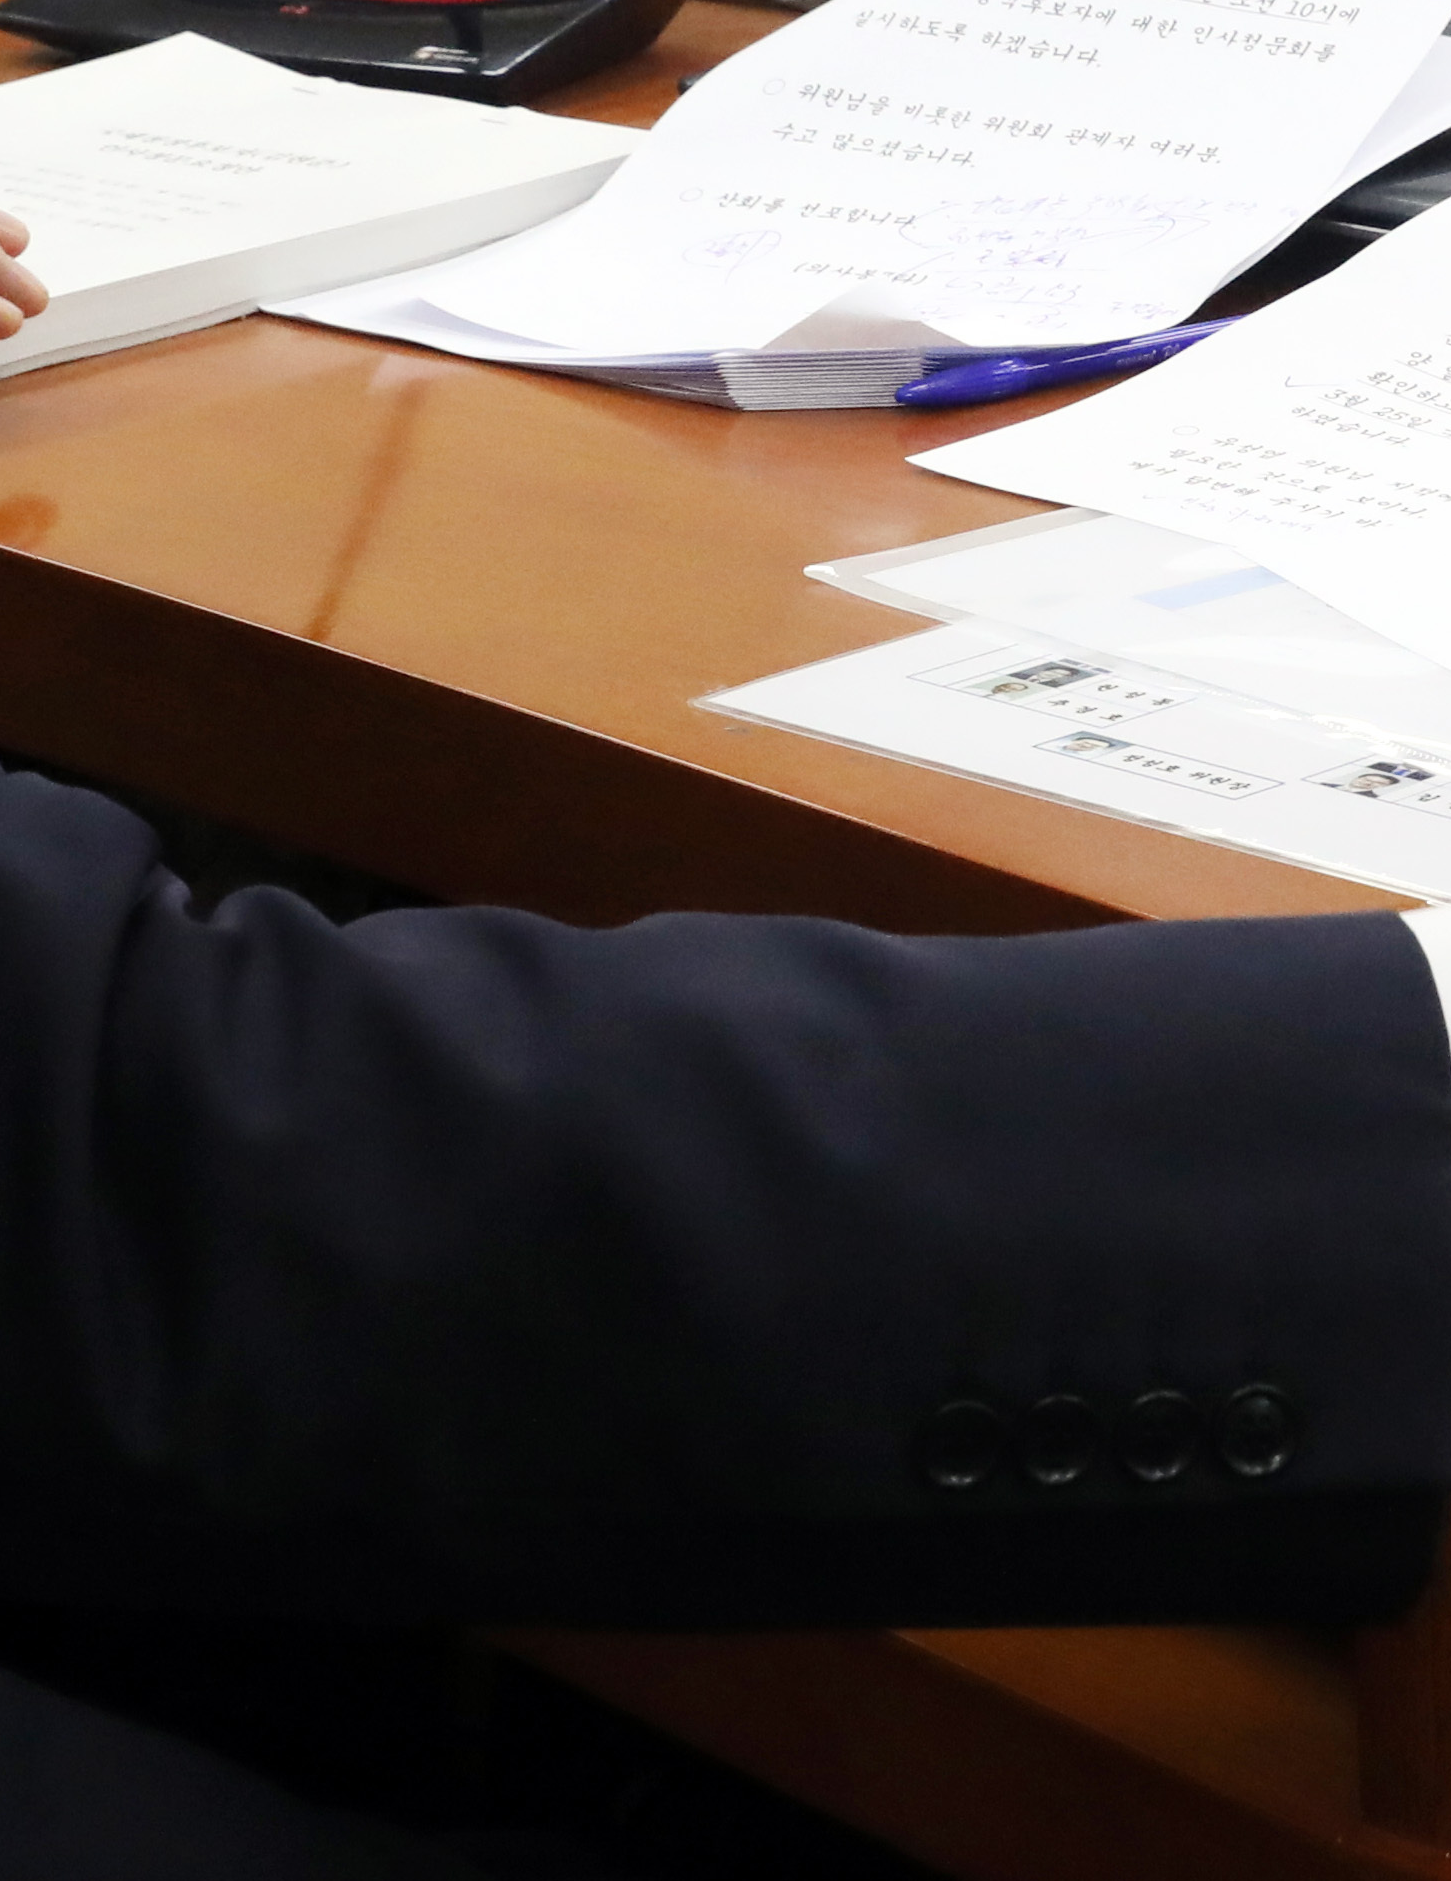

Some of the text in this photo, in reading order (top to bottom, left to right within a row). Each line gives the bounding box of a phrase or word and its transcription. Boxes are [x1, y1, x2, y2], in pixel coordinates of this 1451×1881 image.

[1288, 0, 1361, 26] 10시에
[853, 8, 1103, 69] 실시하도록 하겠습니다.
[1131, 15, 1178, 40] 대한
[1194, 25, 1336, 62] 인사청문회를
[771, 122, 976, 169] 수고 많으셨습니다.
[798, 83, 1223, 166] 위원님을 비롯한 위원회 관계자 여러분.
[718, 190, 918, 230] 산회를 선포합니다.
[1407, 351, 1433, 368] 양
[1323, 388, 1370, 407] 3월
[1371, 406, 1432, 428] 25일
[1169, 448, 1243, 470] 필요한
[1256, 470, 1332, 493] 것으로
[1213, 437, 1287, 460] 유성엽
[1298, 459, 1375, 481] 의원님
[1269, 497, 1345, 519] 주시기
[1187, 770, 1252, 792] 위원장
